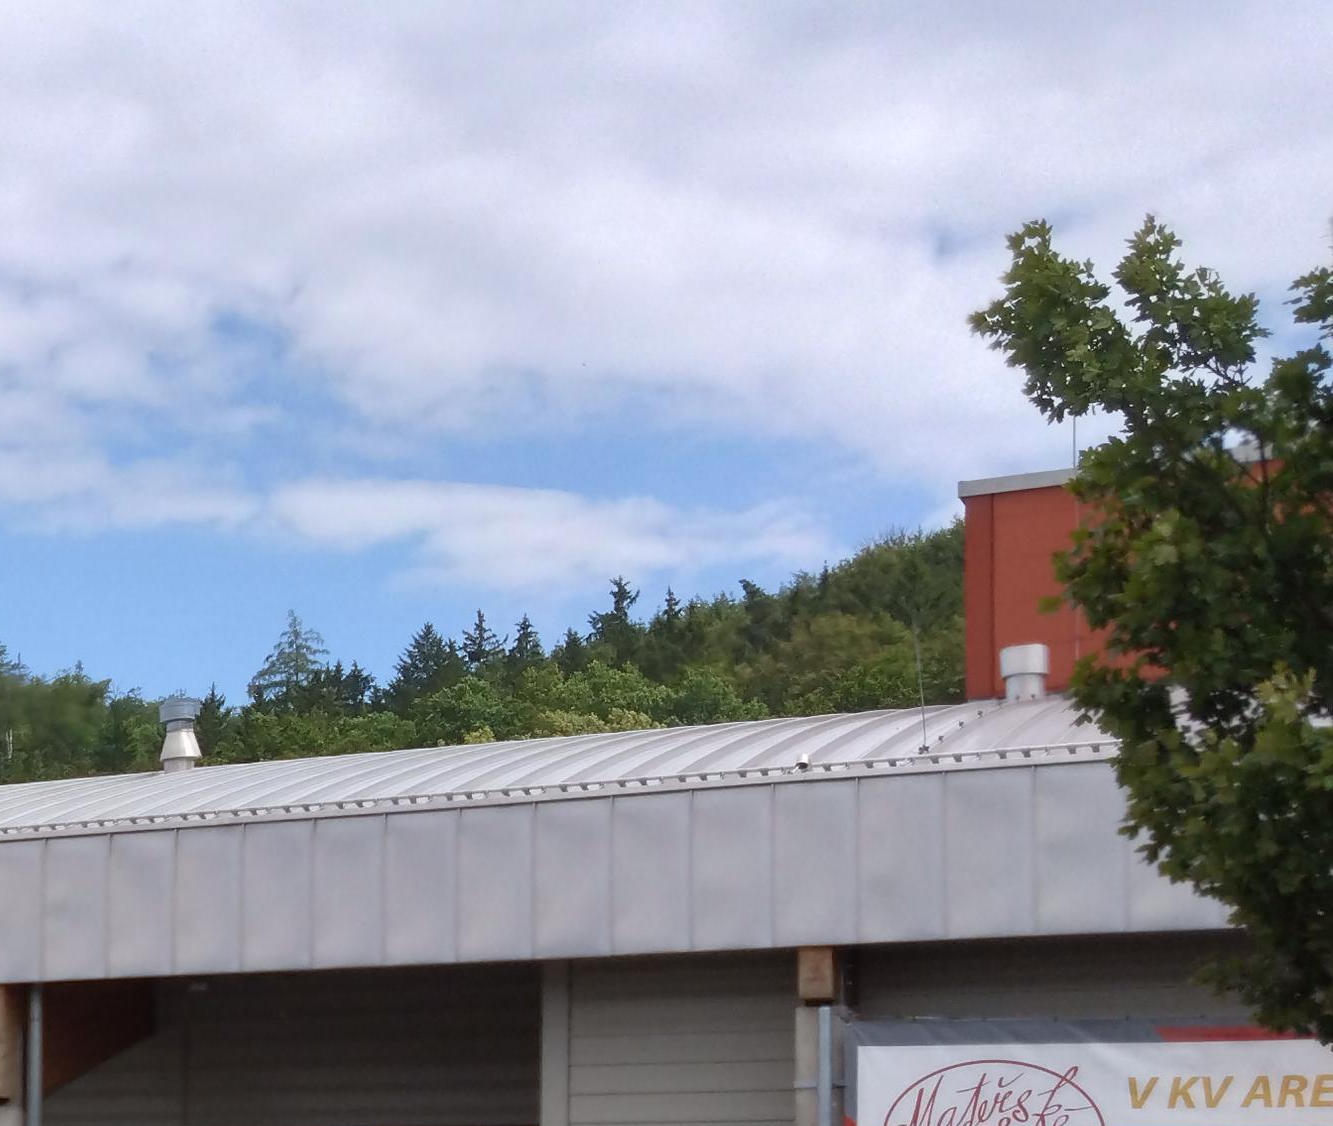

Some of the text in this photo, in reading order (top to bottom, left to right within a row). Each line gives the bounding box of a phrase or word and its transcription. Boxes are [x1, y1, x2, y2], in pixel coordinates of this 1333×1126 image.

[1128, 1074, 1333, 1109] V KV ARE
